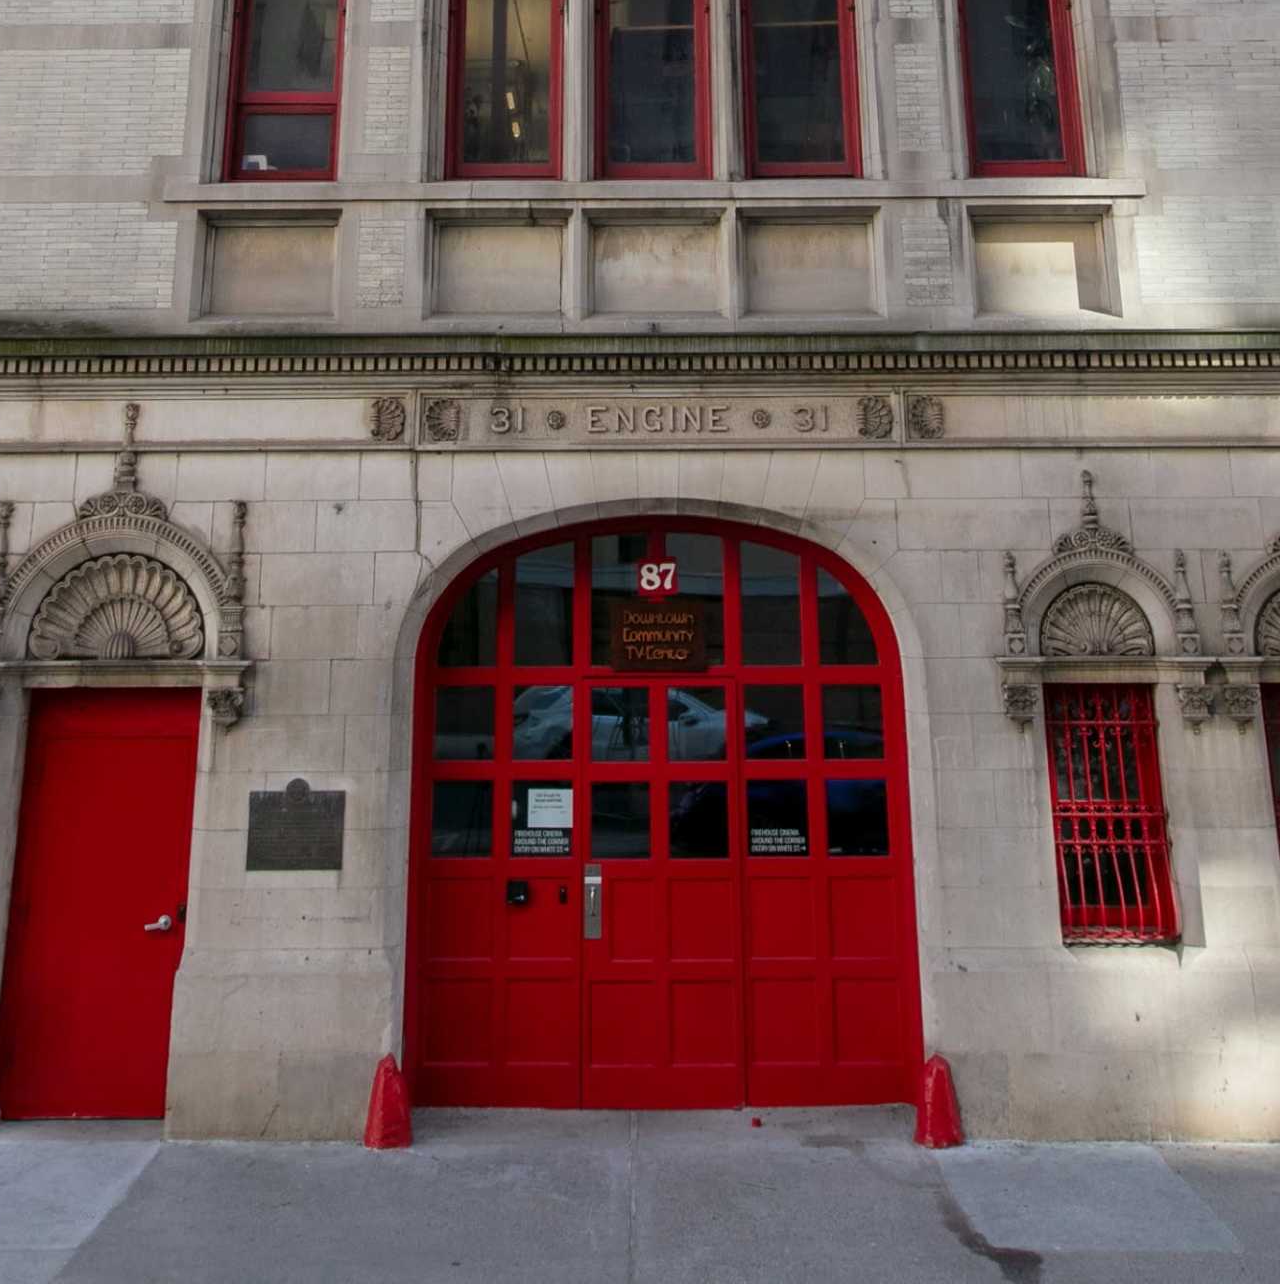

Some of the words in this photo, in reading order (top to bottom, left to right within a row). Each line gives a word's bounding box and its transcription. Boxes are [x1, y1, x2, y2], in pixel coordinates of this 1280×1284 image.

[490, 406, 524, 434] 31
[586, 405, 730, 434] ENGINE
[794, 406, 830, 433] 31
[640, 563, 676, 591] 87
